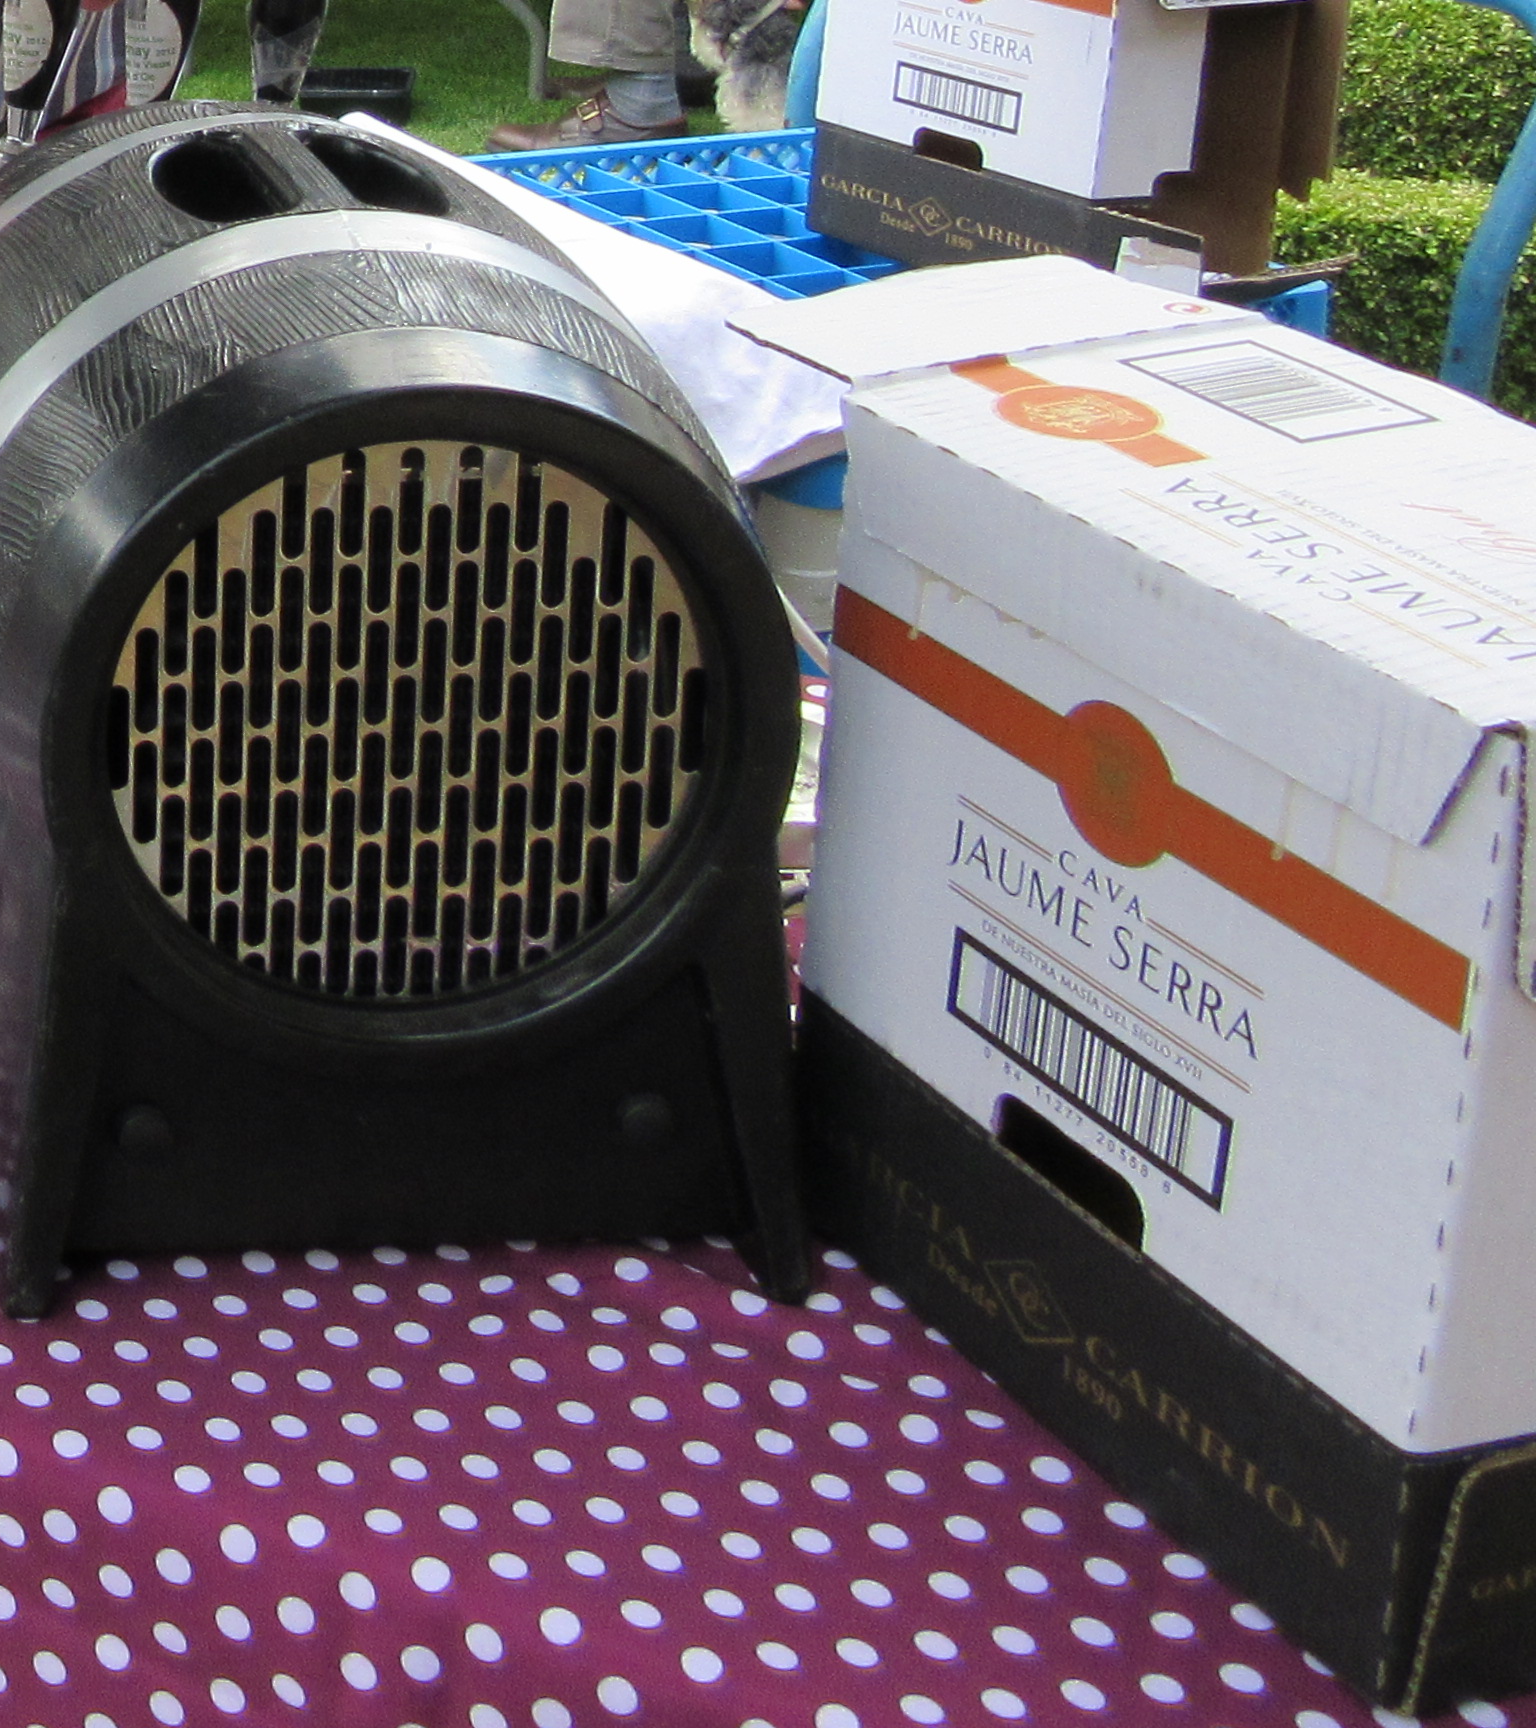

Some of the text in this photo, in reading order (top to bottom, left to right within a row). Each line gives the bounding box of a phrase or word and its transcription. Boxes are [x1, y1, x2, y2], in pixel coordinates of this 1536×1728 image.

[893, 11, 1033, 64] JAUME SERRA
[945, 6, 983, 25] CAVA
[821, 174, 904, 211] GARCIA
[1164, 477, 1344, 559] SERRA
[1246, 548, 1354, 602] CAVA
[1058, 850, 1144, 921] CAVA
[946, 819, 1259, 1062] JAUME SERRA
[1063, 1356, 1124, 1423] 1890
[1085, 1336, 1349, 1569] CARRION
